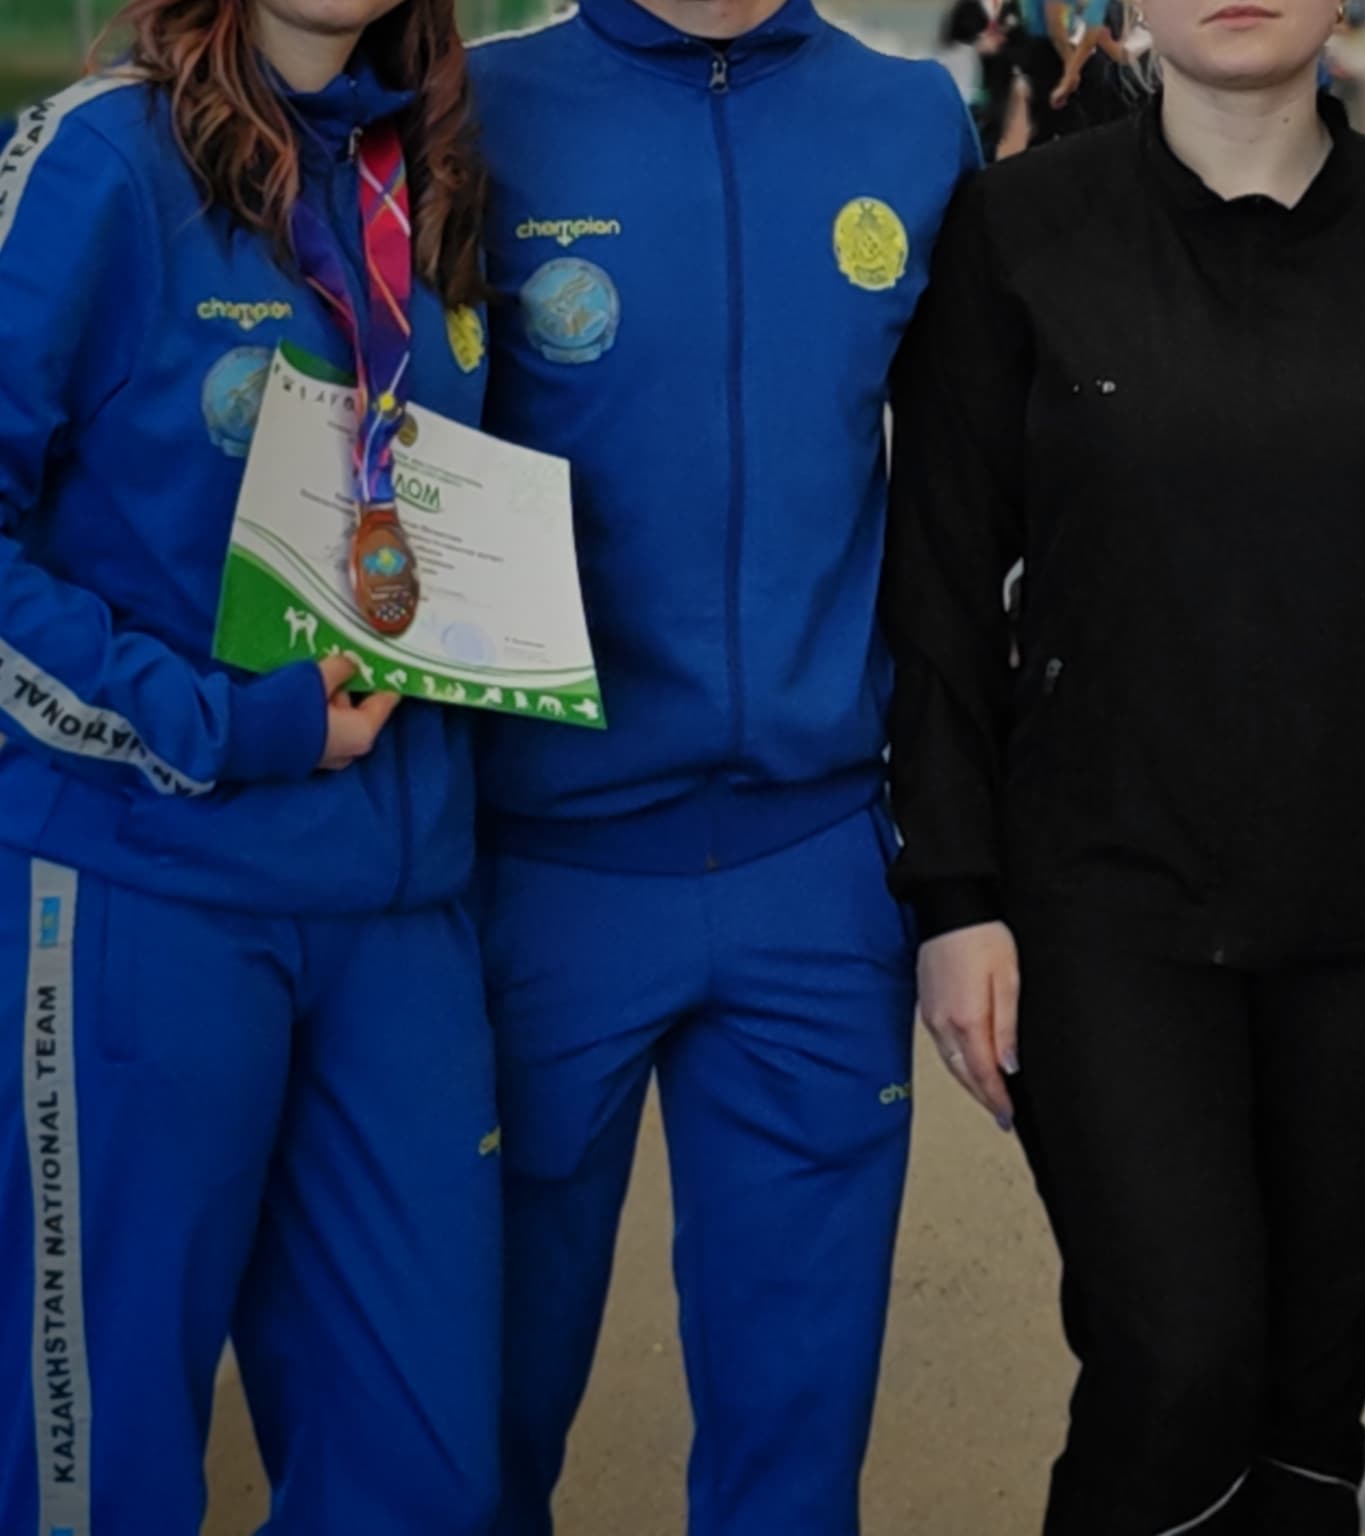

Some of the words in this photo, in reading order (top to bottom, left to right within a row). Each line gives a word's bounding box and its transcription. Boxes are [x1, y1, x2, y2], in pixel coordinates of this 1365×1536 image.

[515, 215, 621, 247] champion
[395, 472, 441, 511] ЛОМ
[35, 984, 58, 1082] TEAM
[38, 1091, 67, 1257] NATIONAL
[42, 1266, 76, 1485] KAZAKHSTAN
